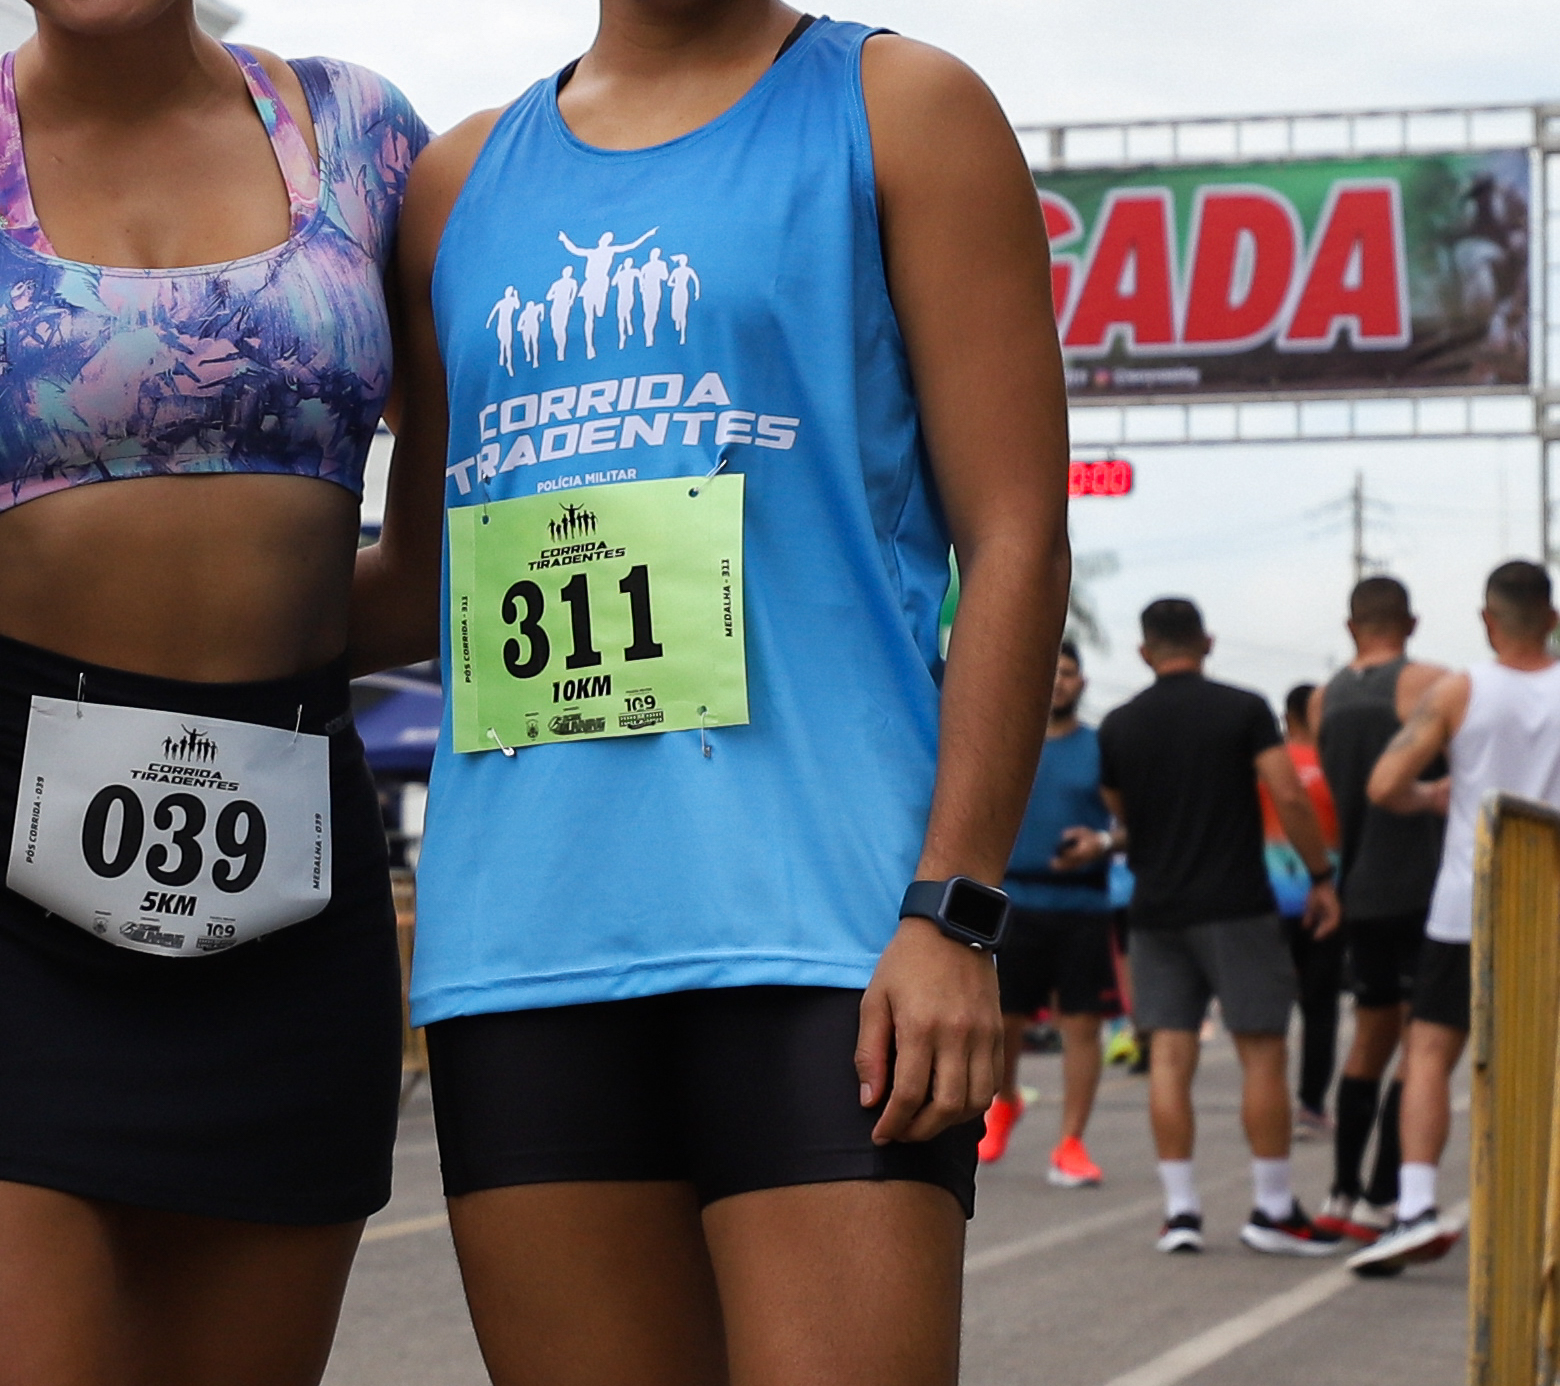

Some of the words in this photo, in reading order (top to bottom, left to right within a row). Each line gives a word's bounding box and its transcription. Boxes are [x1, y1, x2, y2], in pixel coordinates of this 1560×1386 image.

[478, 371, 731, 442] CORRIDA
[537, 473, 582, 493] POLÍCIA
[585, 468, 637, 486] MILITAR
[528, 548, 626, 571] TIRADENTES
[541, 541, 607, 559] CORRIDA
[501, 564, 664, 679] 311
[723, 585, 734, 637] MEDALHA
[461, 619, 471, 661] CORRIDA
[552, 674, 612, 704] 10KM
[130, 769, 240, 791] TIRADENTES
[148, 763, 222, 780] CORRIDA
[29, 801, 41, 843] CORRIDA
[35, 776, 45, 795] 039
[81, 784, 267, 894] 039
[313, 841, 323, 890] MEDALHA
[139, 891, 198, 917] 5KM
